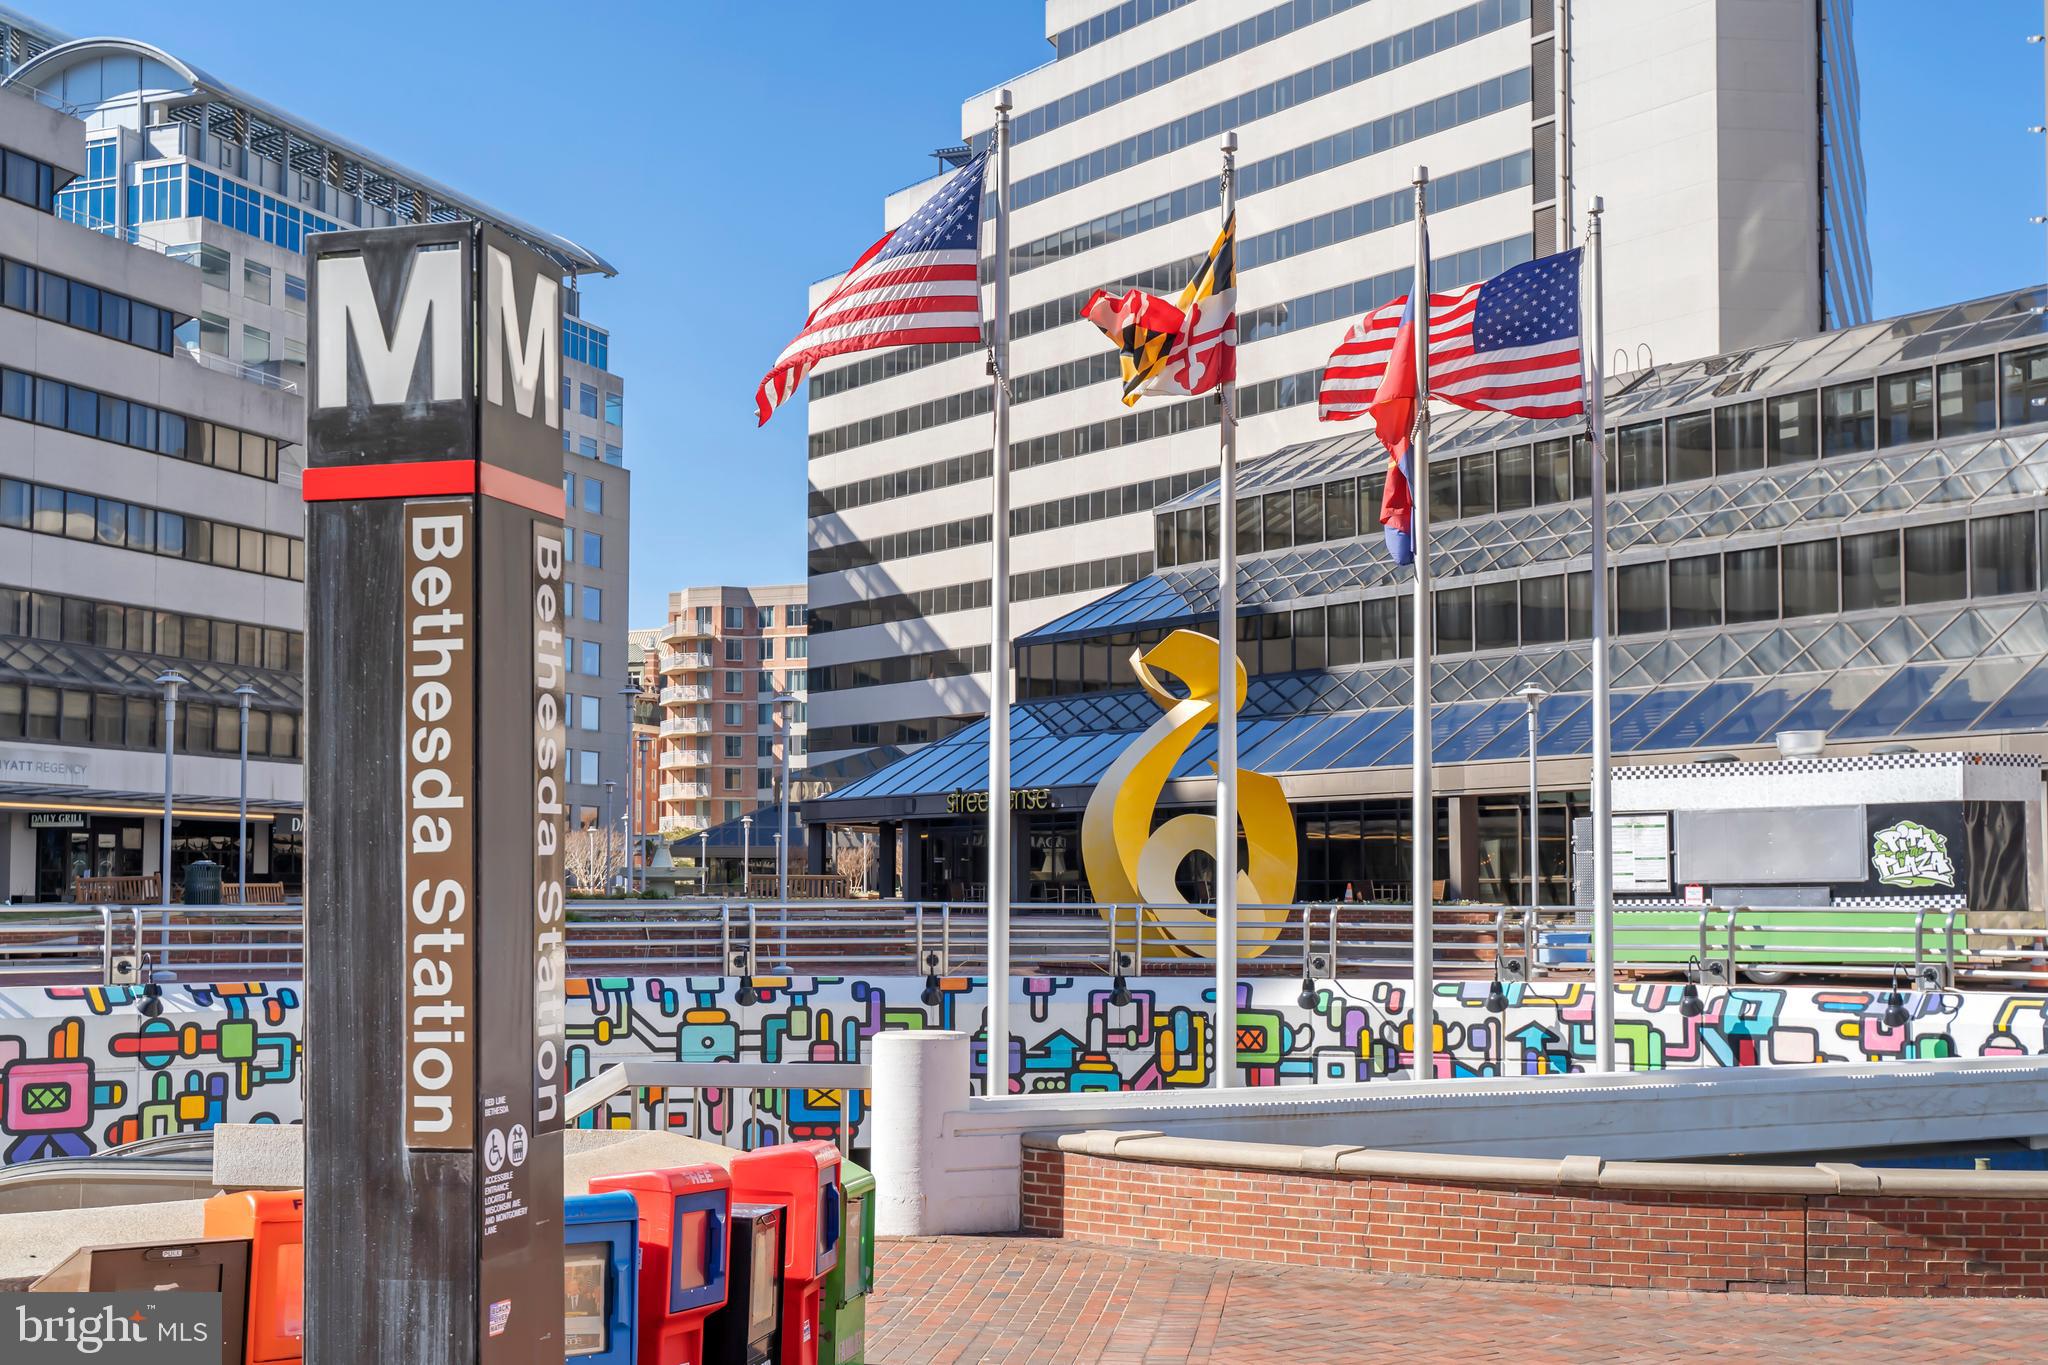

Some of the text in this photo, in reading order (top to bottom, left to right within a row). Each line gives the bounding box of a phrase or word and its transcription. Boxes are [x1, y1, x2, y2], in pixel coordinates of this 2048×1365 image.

[317, 249, 463, 409] M
[487, 244, 560, 430] M
[36, 761, 88, 775] REGENCY
[31, 813, 83, 824] DAILY GRILL
[411, 515, 466, 1133] Bethesda Station
[536, 535, 564, 1123] Bethesda Station
[1873, 851, 1952, 877] PLAZA
[485, 1095, 506, 1106] RED LINE
[484, 1170, 514, 1184] ACCESSIBLE
[484, 1182, 510, 1195] ENTRANCE
[484, 1190, 512, 1205] LOCATED AT
[484, 1201, 512, 1215] WISCONSIN
[484, 1206, 528, 1225] AND MONTGOMERY
[484, 1224, 498, 1235] LANE
